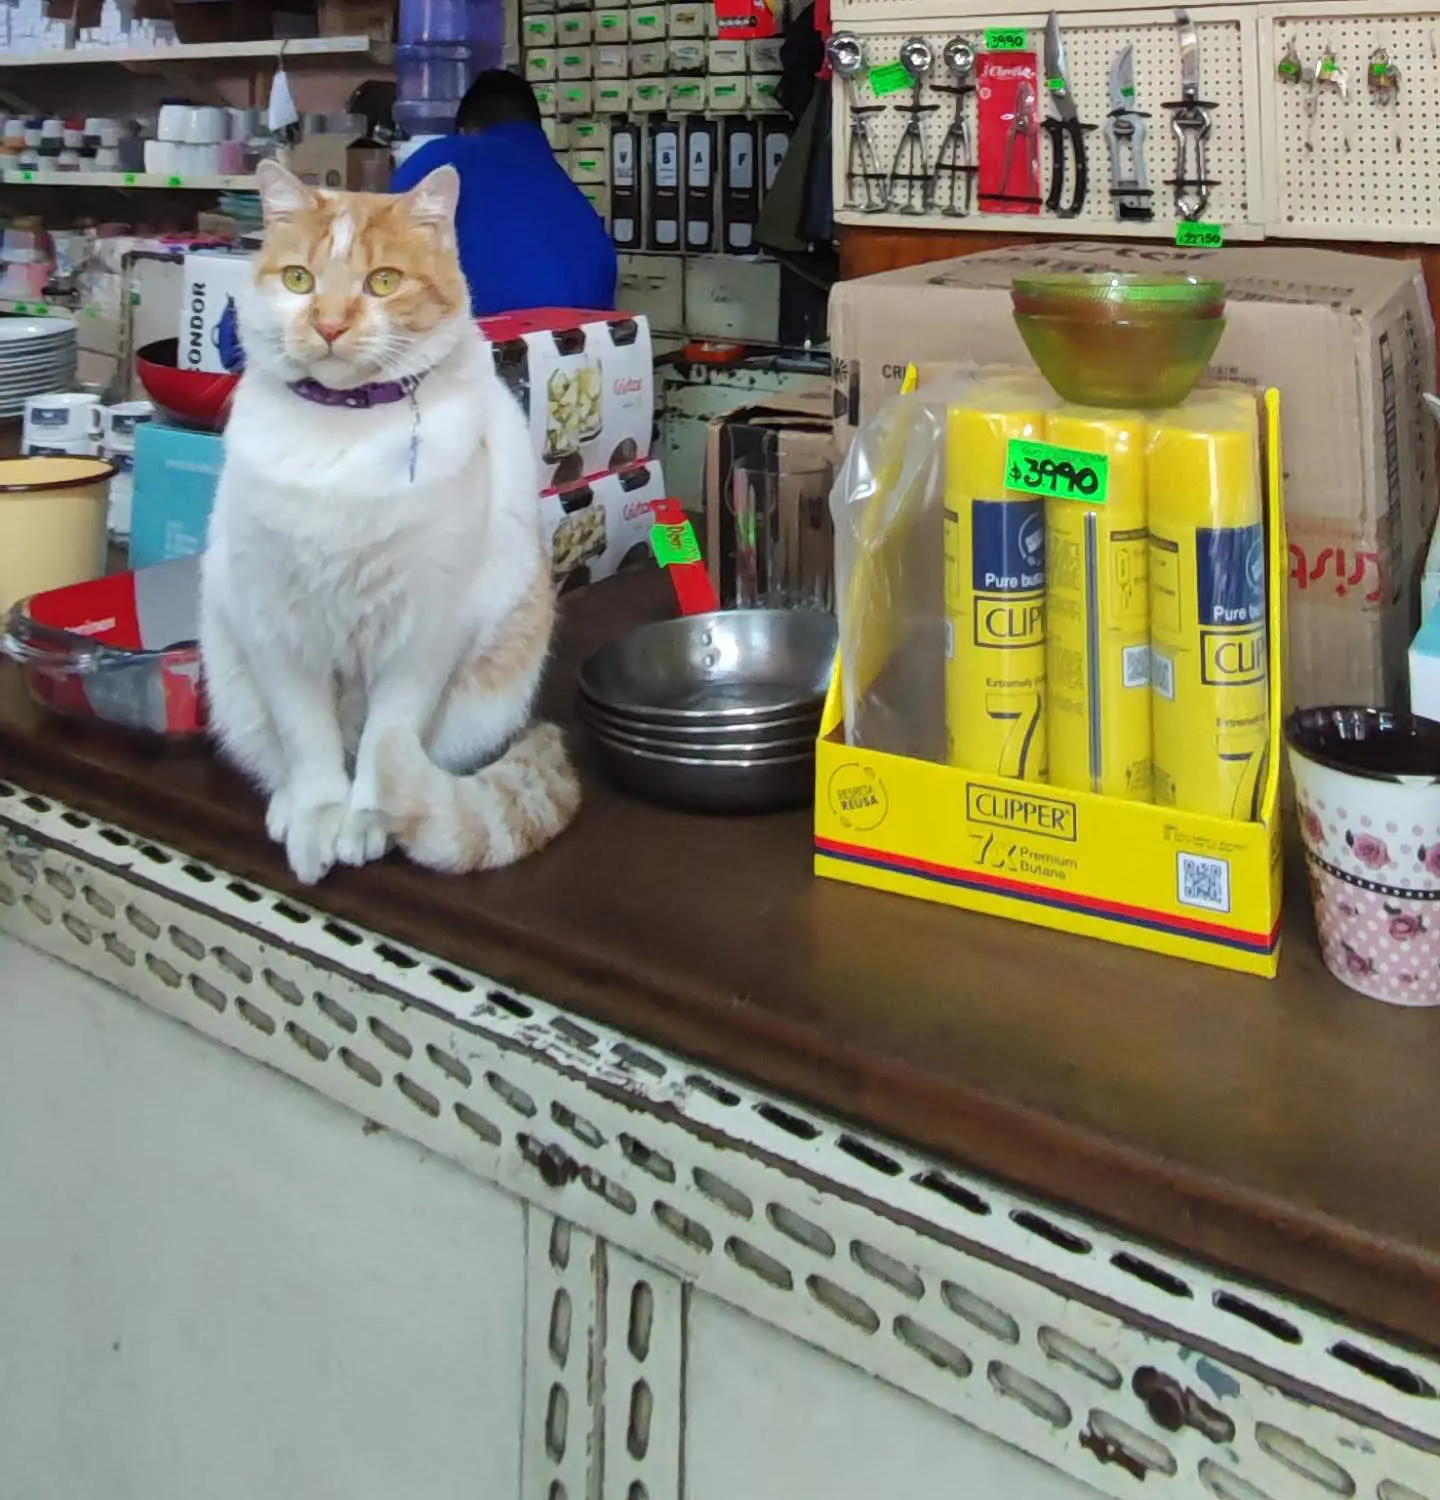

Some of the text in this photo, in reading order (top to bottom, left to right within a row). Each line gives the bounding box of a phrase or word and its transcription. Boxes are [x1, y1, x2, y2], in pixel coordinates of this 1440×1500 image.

[694, 151, 703, 164] A
[187, 282, 206, 371] ONDOR
[984, 572, 1018, 588] Pure
[1213, 605, 1246, 622] Pure
[986, 689, 1042, 779] 7
[975, 792, 1066, 832] CLIPPER
[1020, 846, 1078, 870] Premium
[1020, 860, 1067, 880] Butane
